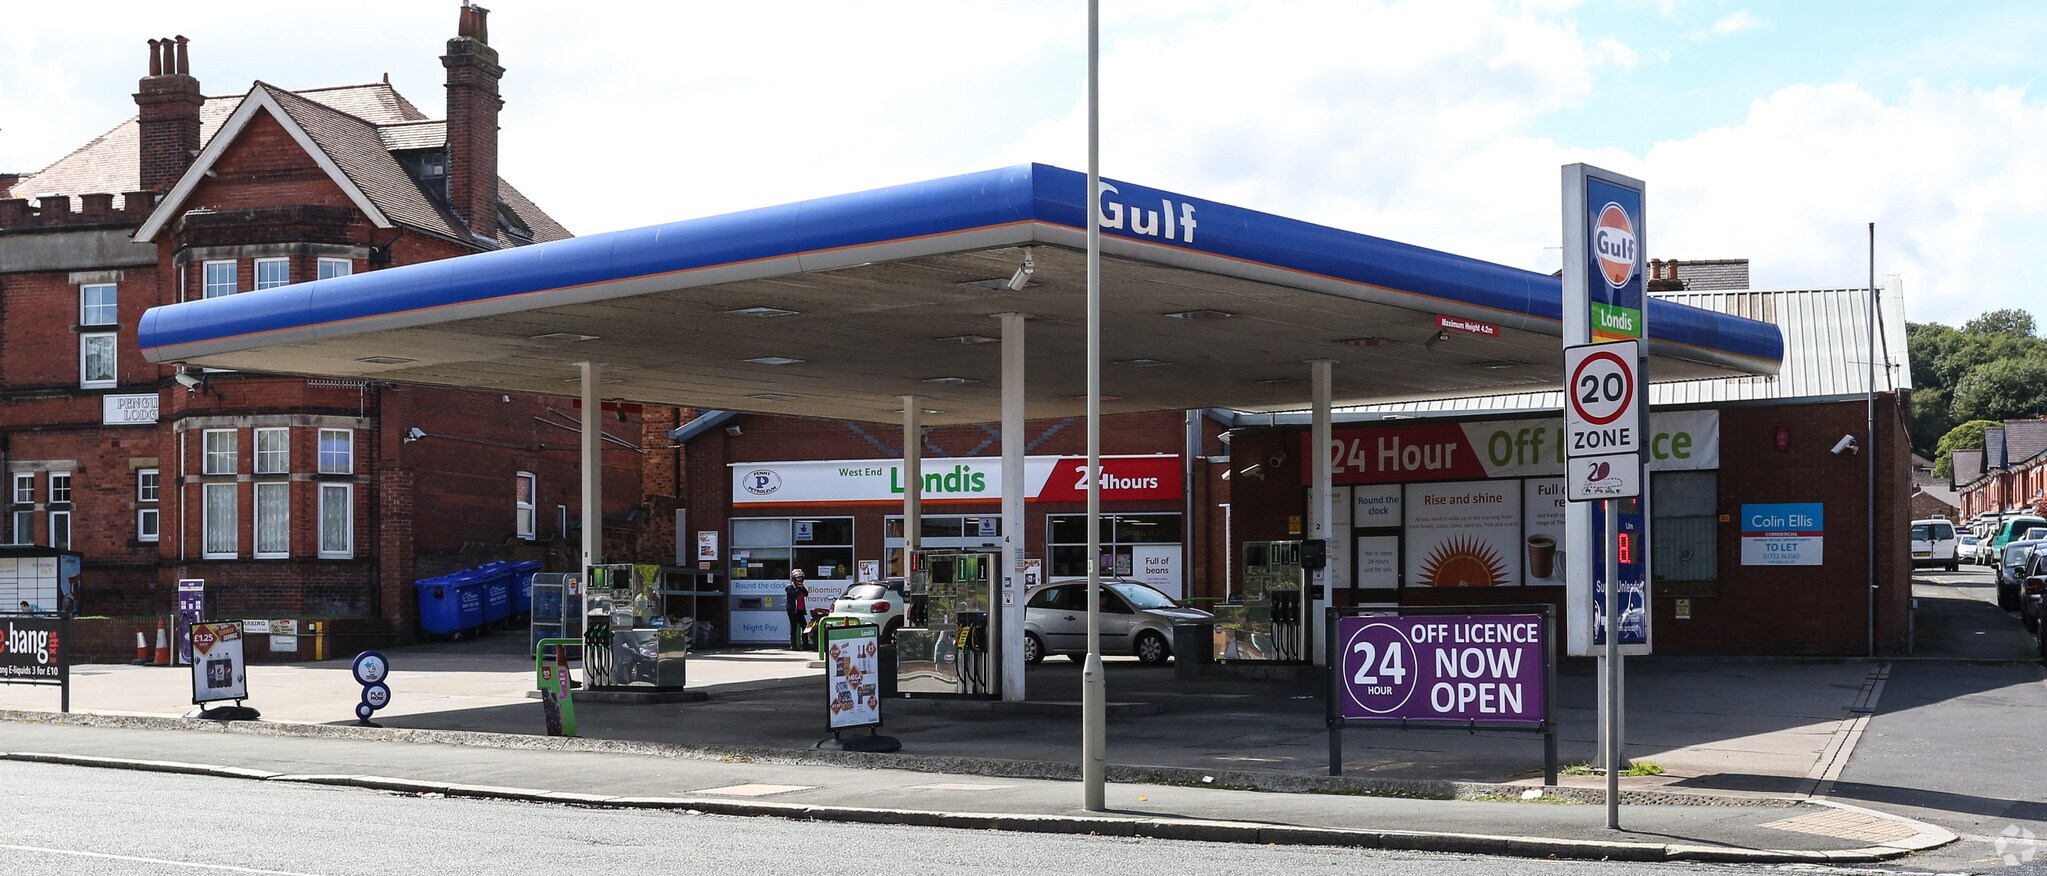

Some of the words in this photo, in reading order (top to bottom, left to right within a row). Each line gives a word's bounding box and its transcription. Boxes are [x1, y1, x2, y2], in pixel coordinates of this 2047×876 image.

[1099, 181, 1197, 243] Gulf
[1597, 230, 1634, 261] Gulf
[1441, 318, 1464, 329] Maximum
[1465, 322, 1480, 333] Height
[1480, 325, 1493, 334] 4.2m
[1600, 308, 1632, 331] Londis
[1580, 372, 1624, 404] 20
[124, 409, 157, 420] LODG
[1574, 428, 1631, 450] ZONE
[1331, 439, 1365, 473] 24
[1378, 436, 1457, 472] Hour
[1488, 427, 1546, 467] Off
[839, 468, 862, 477] West
[865, 468, 882, 476] End
[891, 464, 985, 493] Lndis
[756, 476, 769, 488] P
[748, 485, 777, 494] PETROLEUM
[1538, 483, 1558, 495] Full
[1358, 496, 1383, 504] Round
[1385, 495, 1399, 503] the
[1424, 495, 1446, 505] Rise
[1449, 493, 1470, 504] and
[1473, 492, 1503, 504] shine
[1368, 506, 1389, 515] clock
[1752, 514, 1785, 527] Colin
[1789, 514, 1813, 527] Ellis
[1765, 543, 1778, 551] TO
[1781, 543, 1798, 551] LET
[1145, 557, 1159, 565] Full
[1160, 556, 1170, 565] of
[808, 586, 842, 595] Blooming
[743, 624, 762, 633] Night
[765, 624, 778, 633] Pay
[1411, 624, 1448, 643] OFF
[1454, 623, 1538, 643] LICENCE
[1354, 641, 1406, 684] 24
[1435, 647, 1523, 679] NOW
[32, 666, 36, 675] 3
[37, 666, 45, 675] for
[46, 666, 59, 676] £10
[1368, 686, 1393, 695] HOUR
[1430, 682, 1523, 714] OPEN
